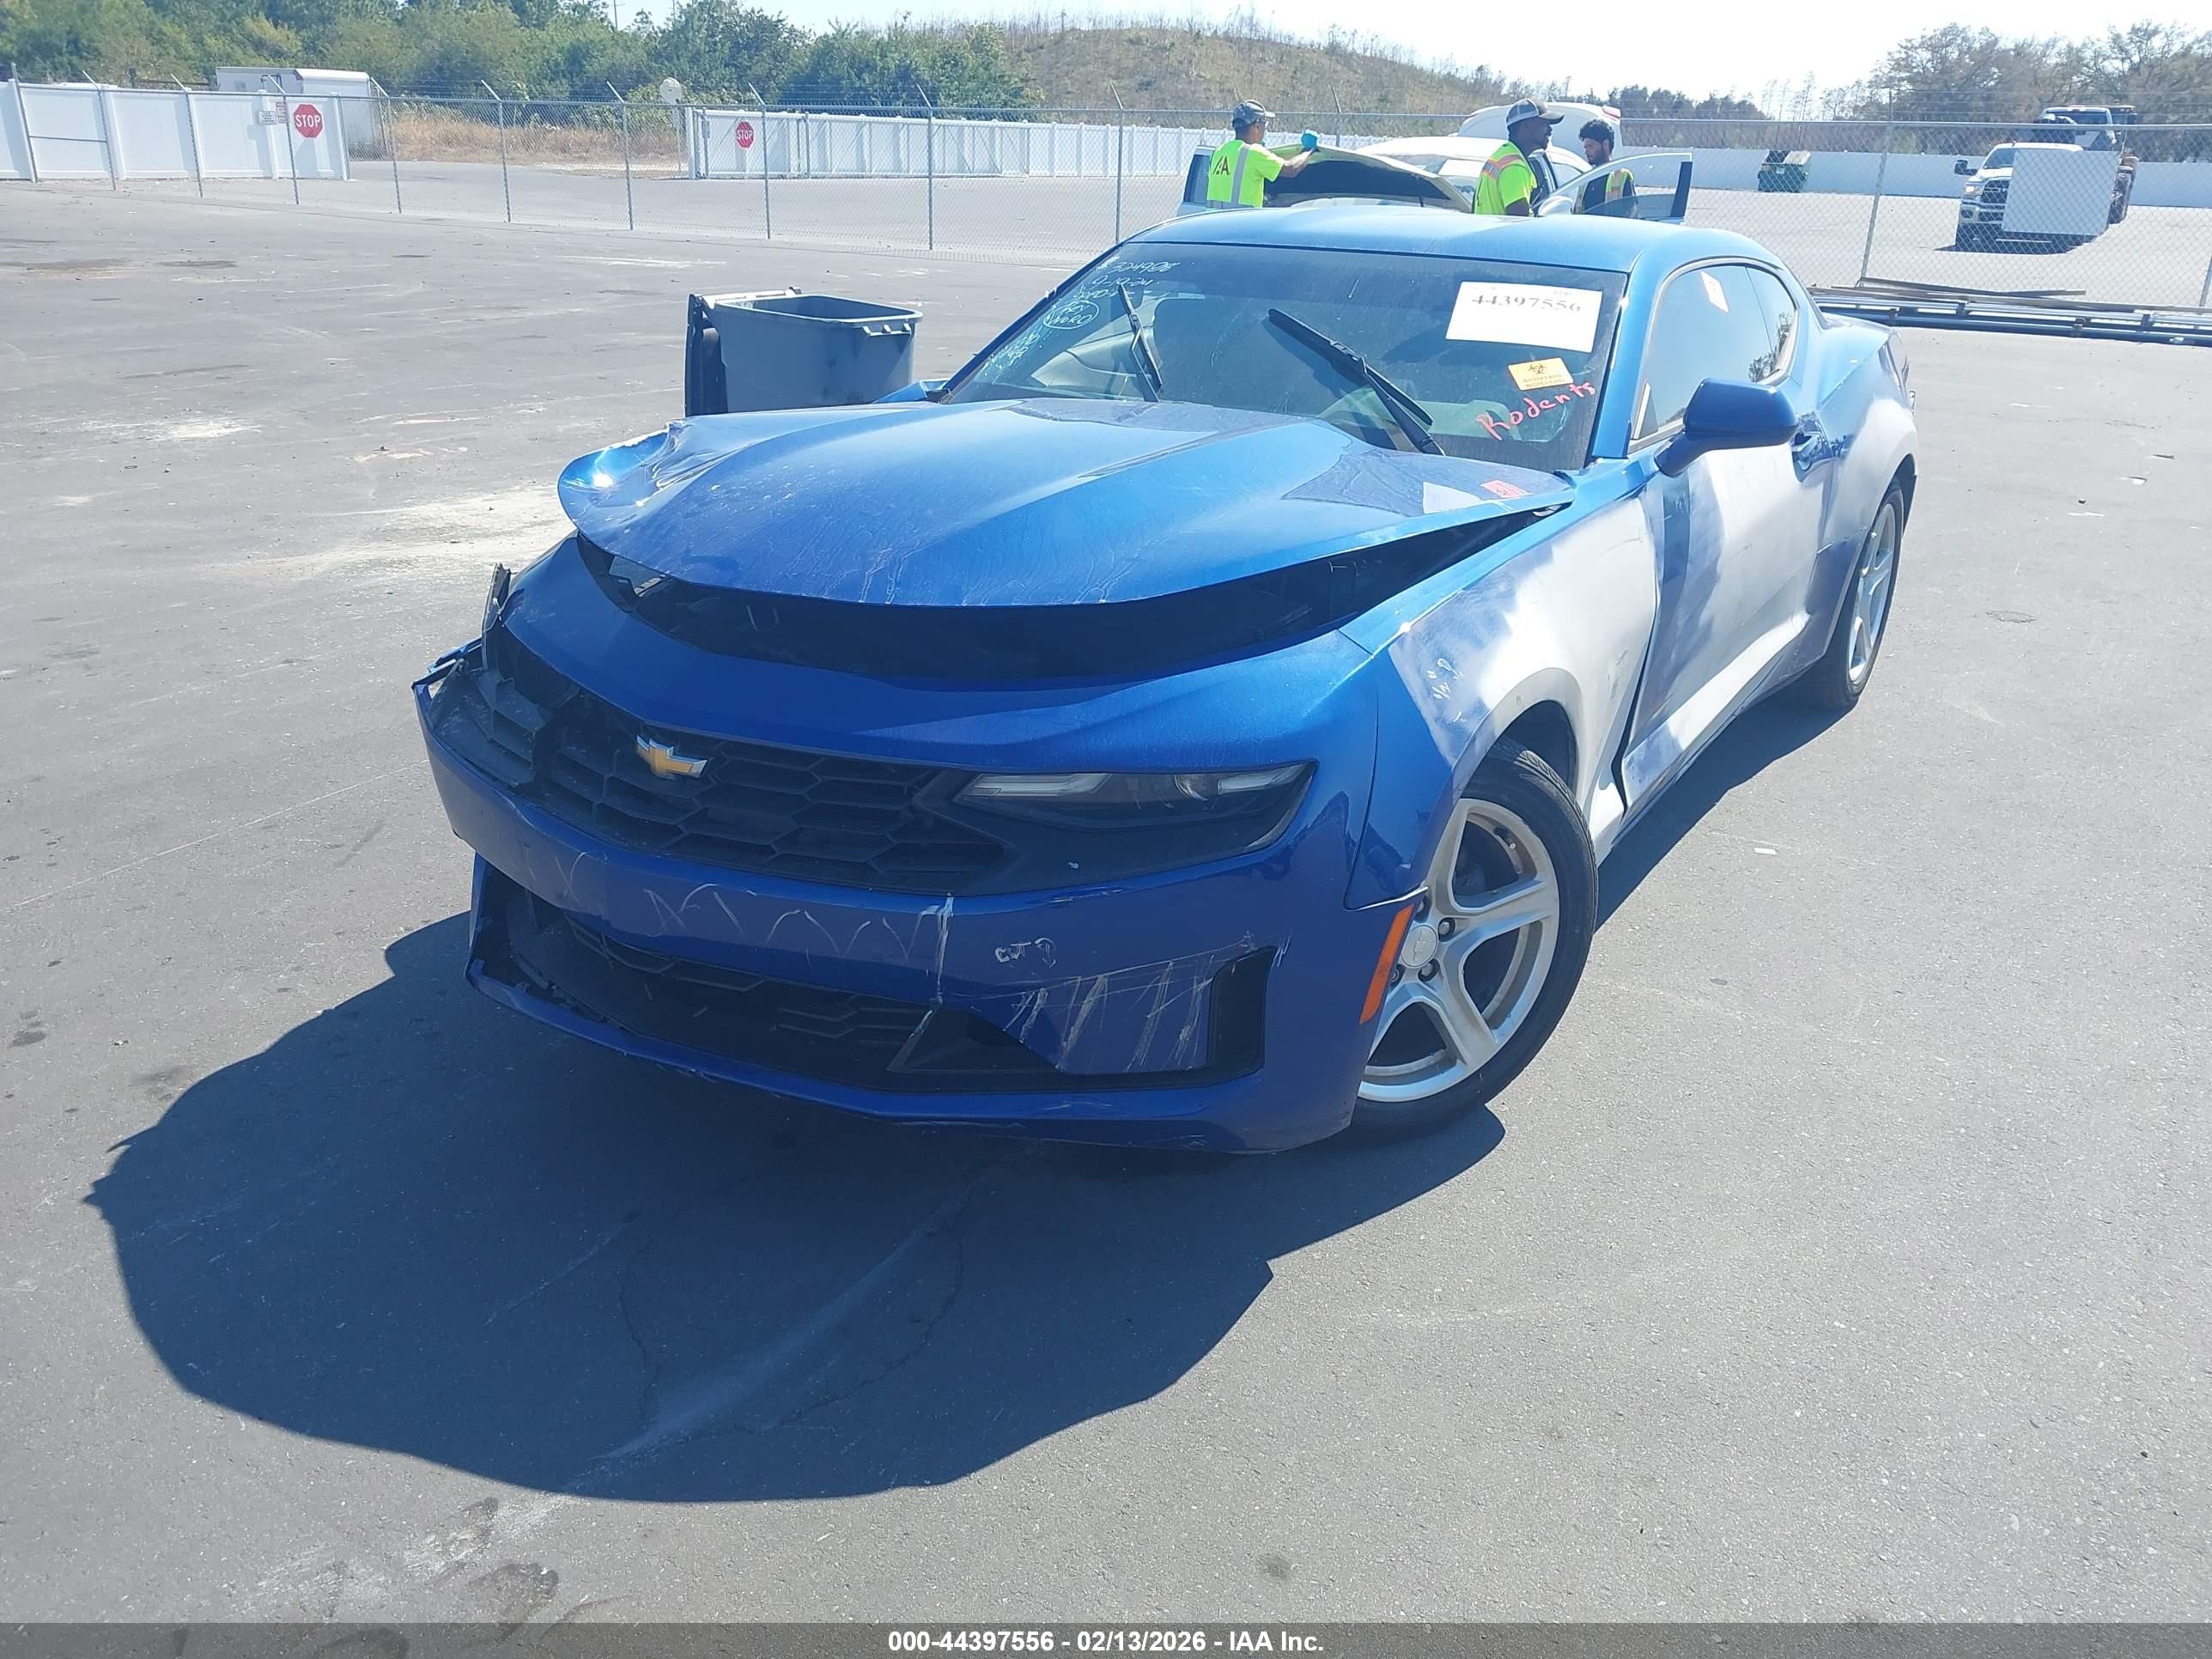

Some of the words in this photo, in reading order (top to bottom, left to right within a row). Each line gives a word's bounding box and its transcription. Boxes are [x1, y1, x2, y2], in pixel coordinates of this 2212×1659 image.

[295, 114, 320, 127] STOP
[737, 130, 752, 141] STOP
[1472, 295, 1581, 312] 44397556
[1476, 381, 1595, 441] Rodents
